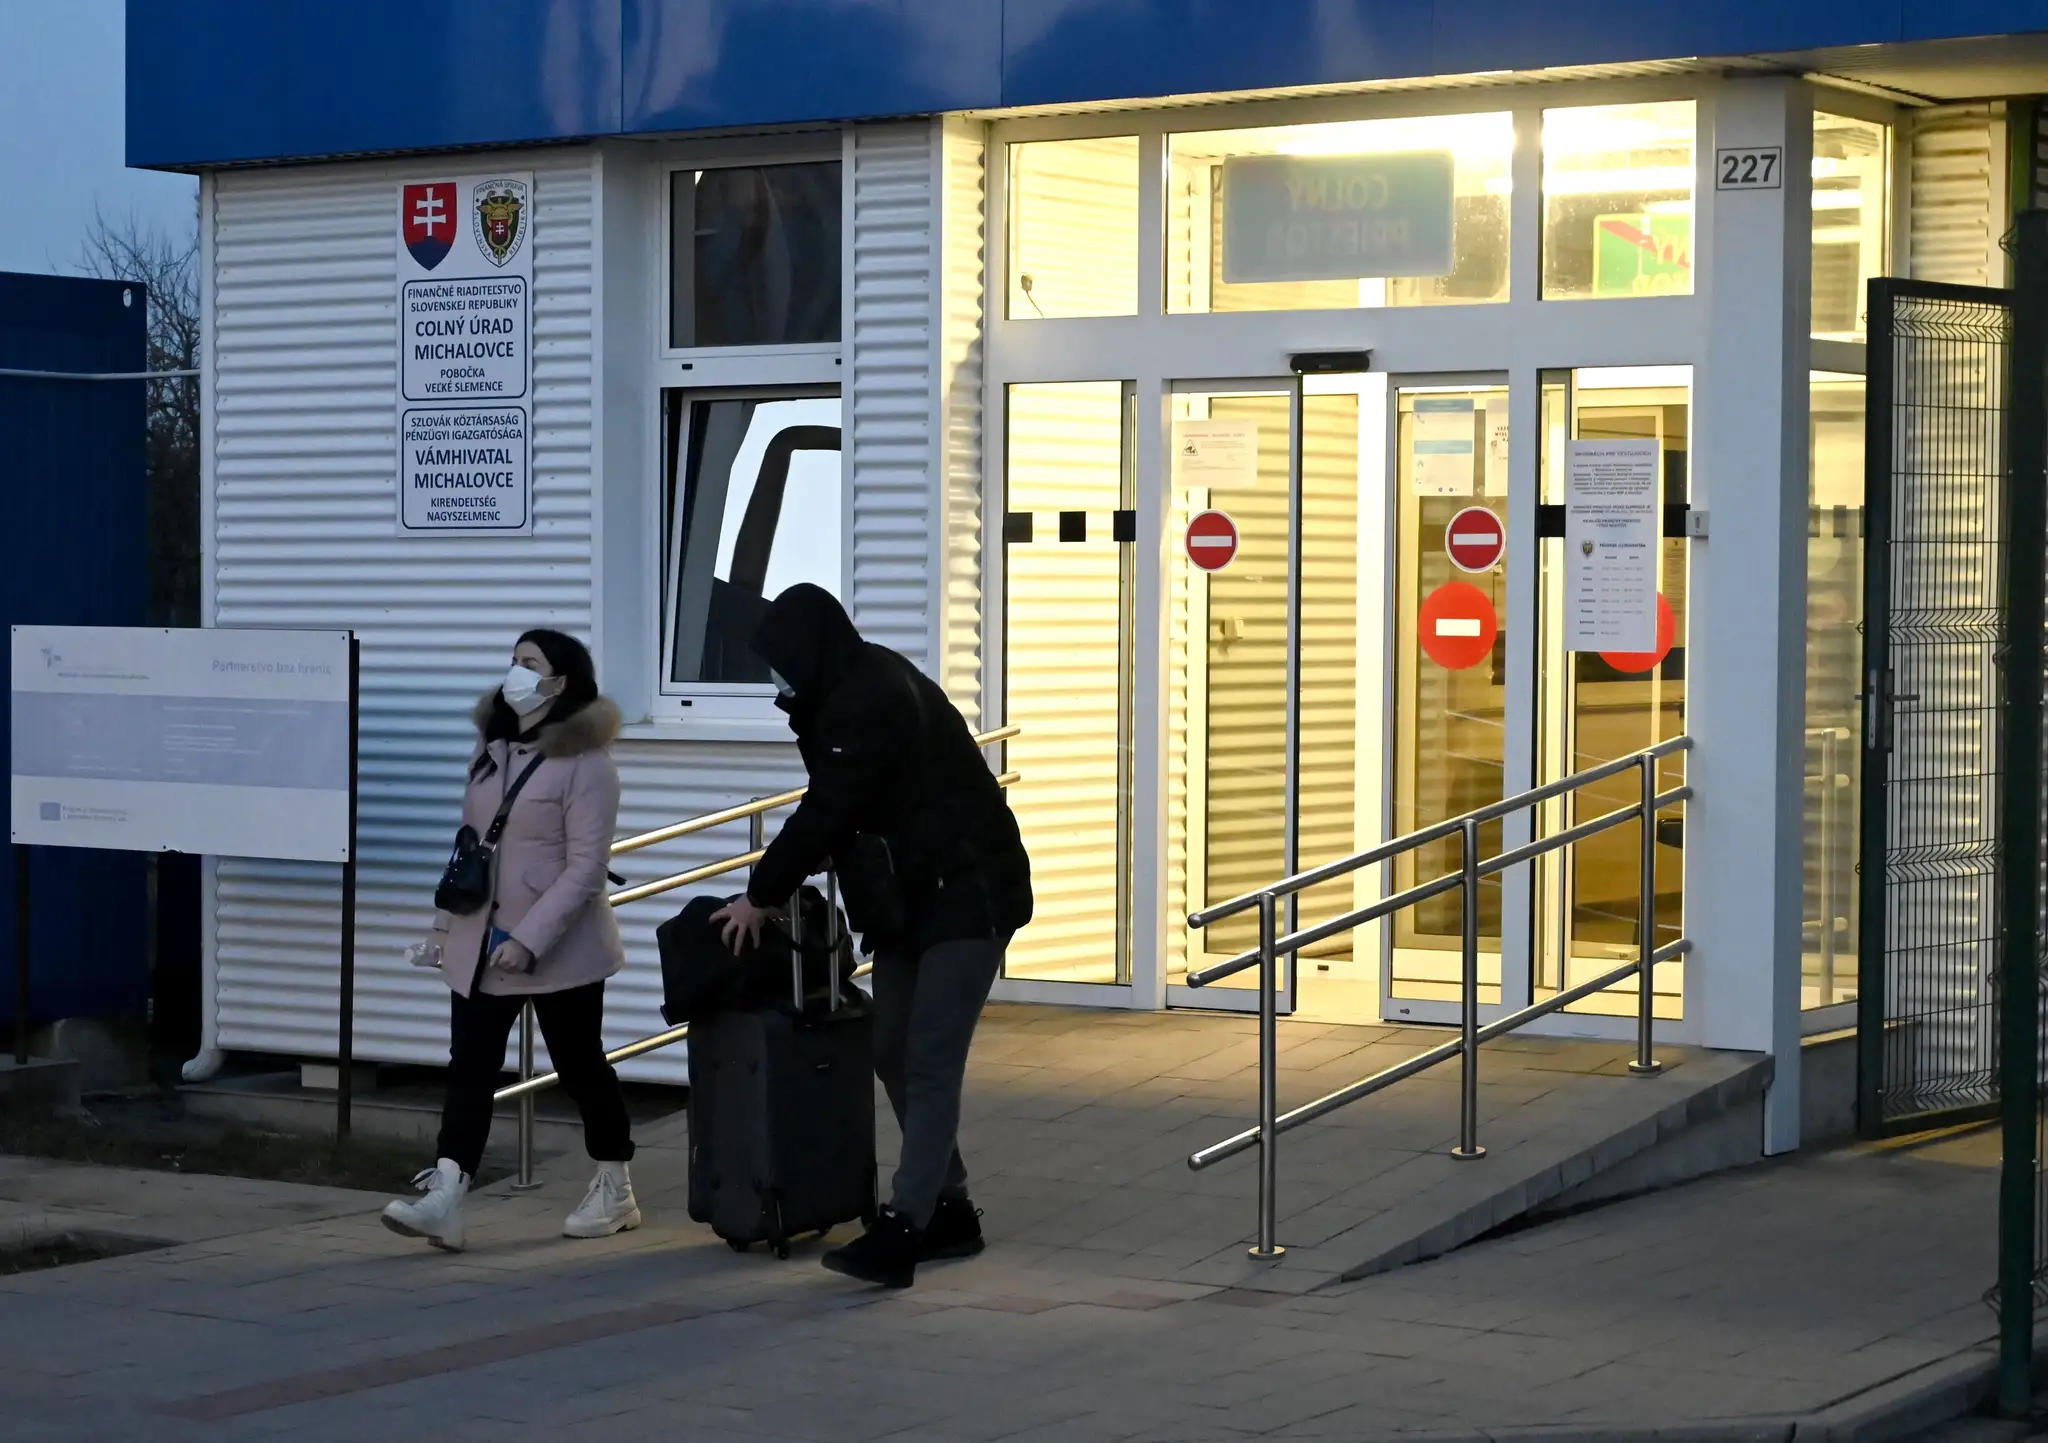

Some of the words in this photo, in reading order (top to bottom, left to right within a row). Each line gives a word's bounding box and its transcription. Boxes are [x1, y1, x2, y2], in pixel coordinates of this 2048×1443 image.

[1721, 153, 1778, 184] 227
[407, 284, 454, 299] FINANČNÉ
[456, 283, 522, 297] RIADITEĽSTVO
[410, 300, 466, 313] SLOVENSKEJ
[468, 298, 519, 310] REPUBLIKY
[415, 315, 465, 337] COLNÝ
[469, 314, 514, 335] ÚRAD
[414, 341, 514, 360] MICHALOVCE
[440, 365, 485, 379] POBOČKA
[425, 380, 453, 393] VEĽKÉ
[454, 381, 503, 392] SLEMENCE
[411, 414, 451, 427] SZLOVÁK
[453, 412, 519, 427] KÖZTÁRSASÁG
[405, 428, 450, 441] PÉNZÜGYI
[452, 426, 523, 440] IGAZGATÓSÁGA
[415, 445, 513, 466] VÁMHIVATAL
[414, 472, 514, 489] MICHALOVCE
[430, 495, 497, 508] KIRENDELTSÉG
[427, 511, 501, 522] NAGYSZELMENC
